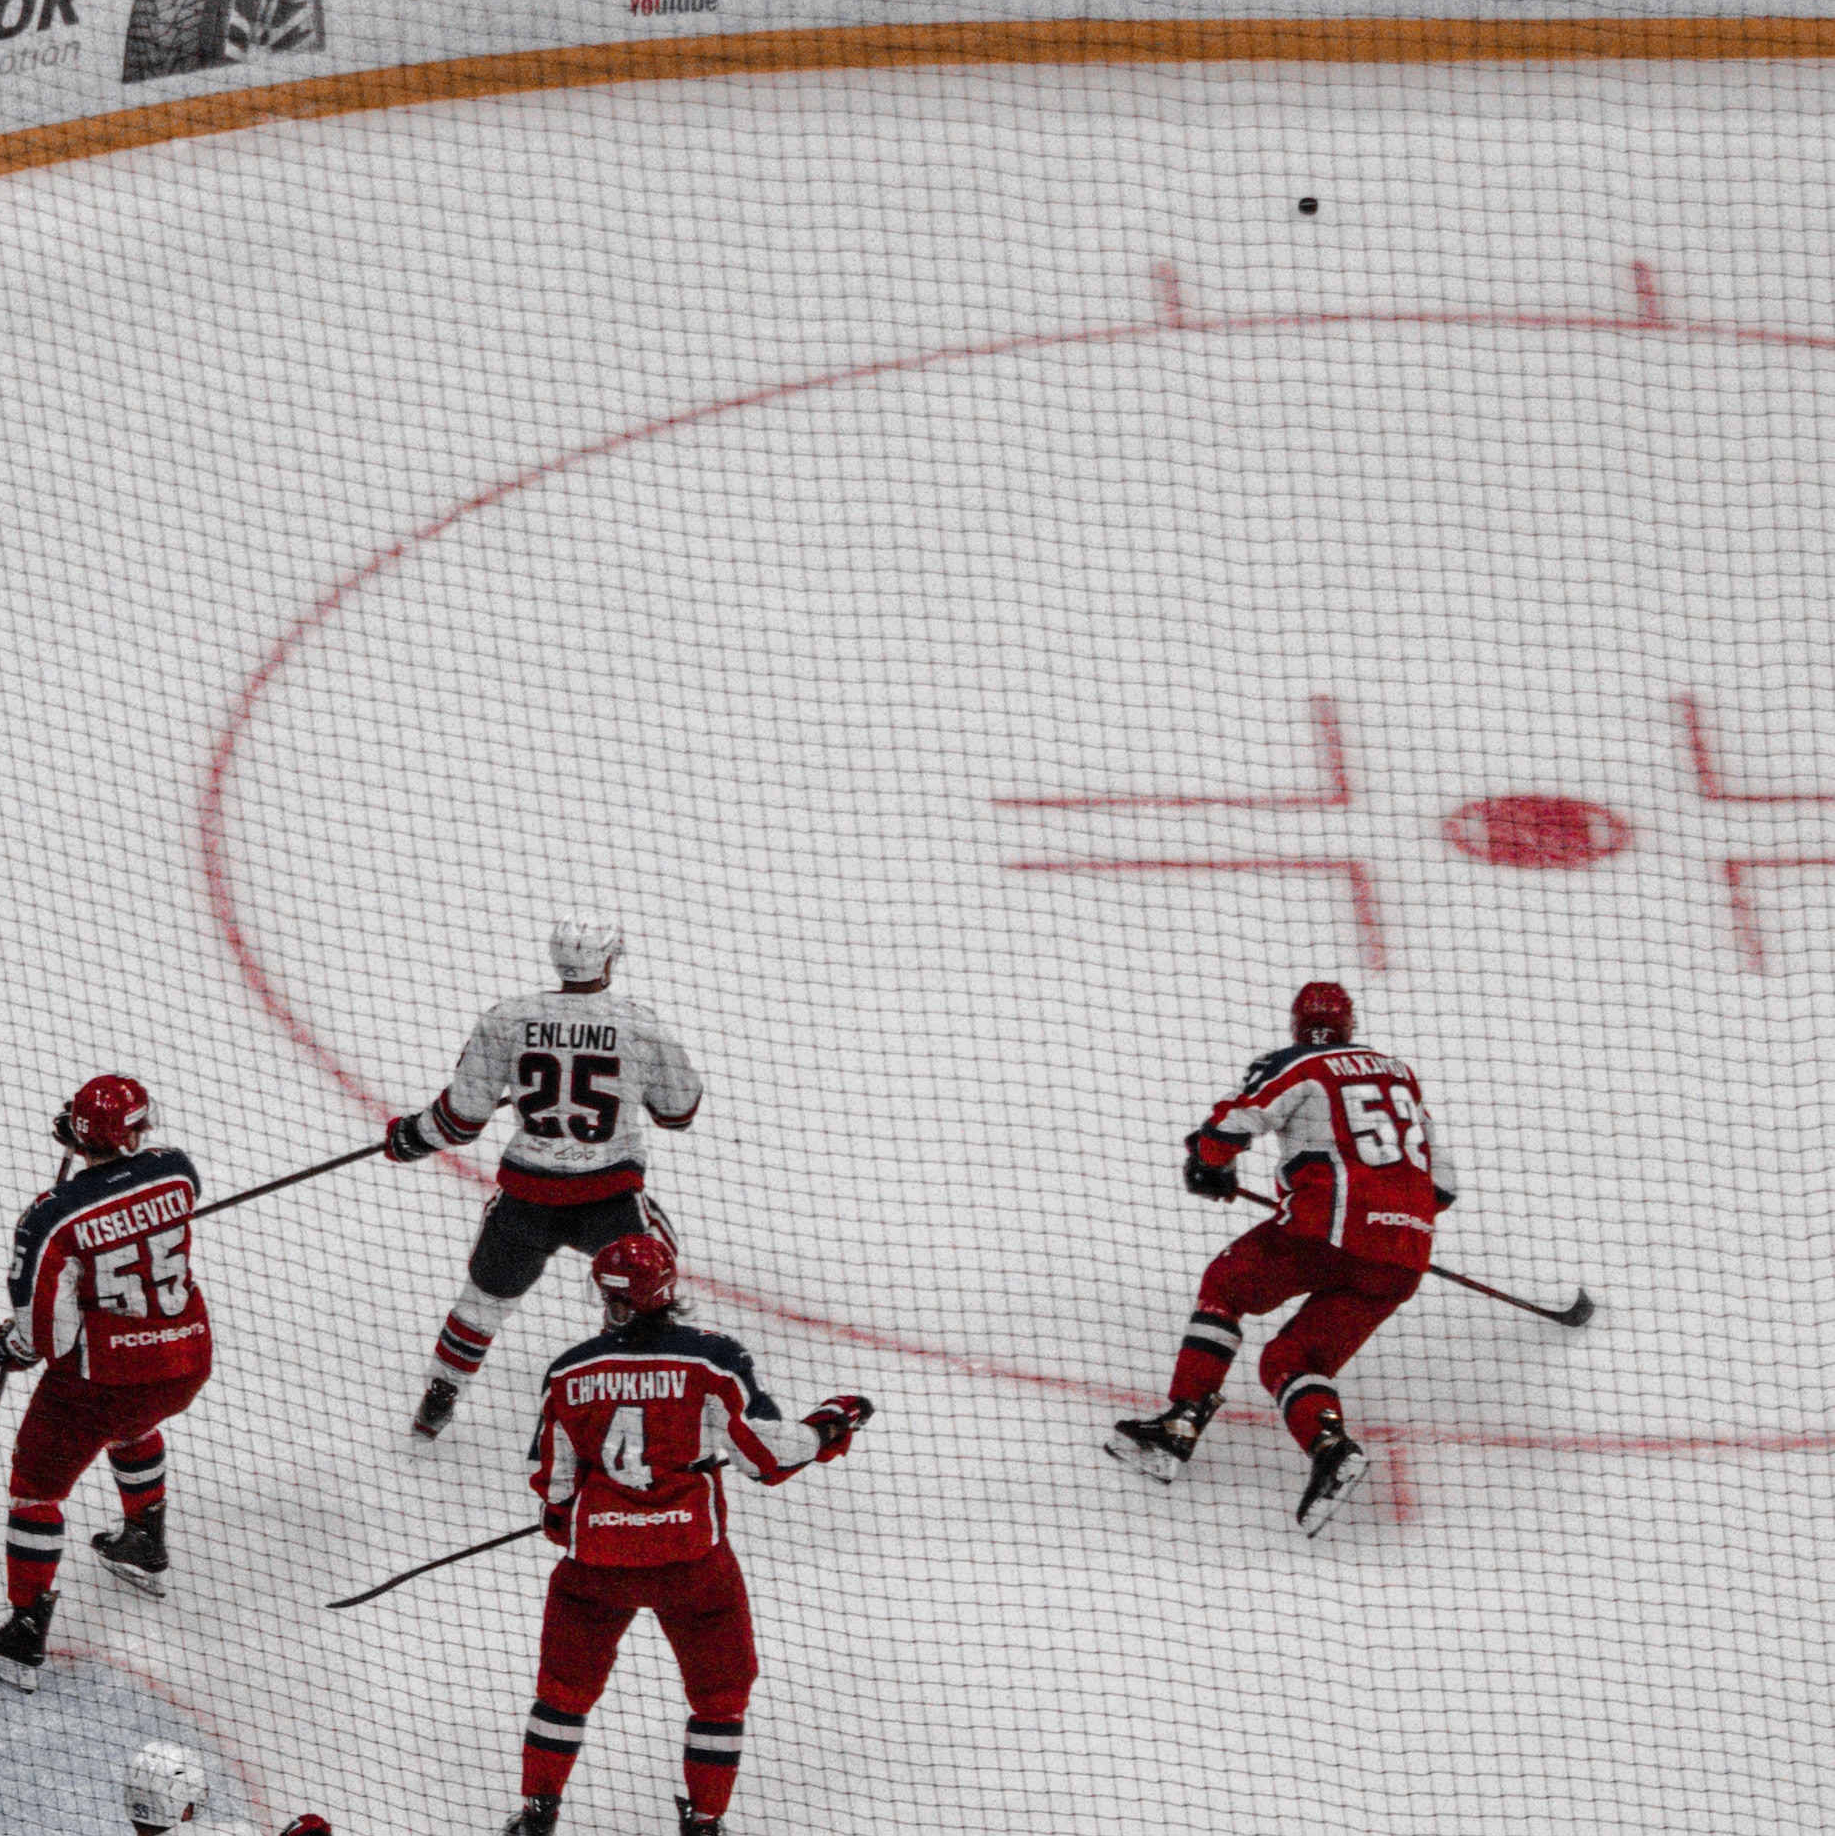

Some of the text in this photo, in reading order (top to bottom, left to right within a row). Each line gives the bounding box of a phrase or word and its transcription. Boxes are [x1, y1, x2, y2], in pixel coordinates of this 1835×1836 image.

[524, 1021, 618, 1052] ENLUND
[517, 1052, 622, 1144] 25
[1340, 1083, 1430, 1173] 52
[72, 1187, 191, 1251] KISELEVICH
[94, 1224, 191, 1319] 55
[566, 1370, 687, 1406] CHMYKHOV
[601, 1405, 654, 1491] 4
